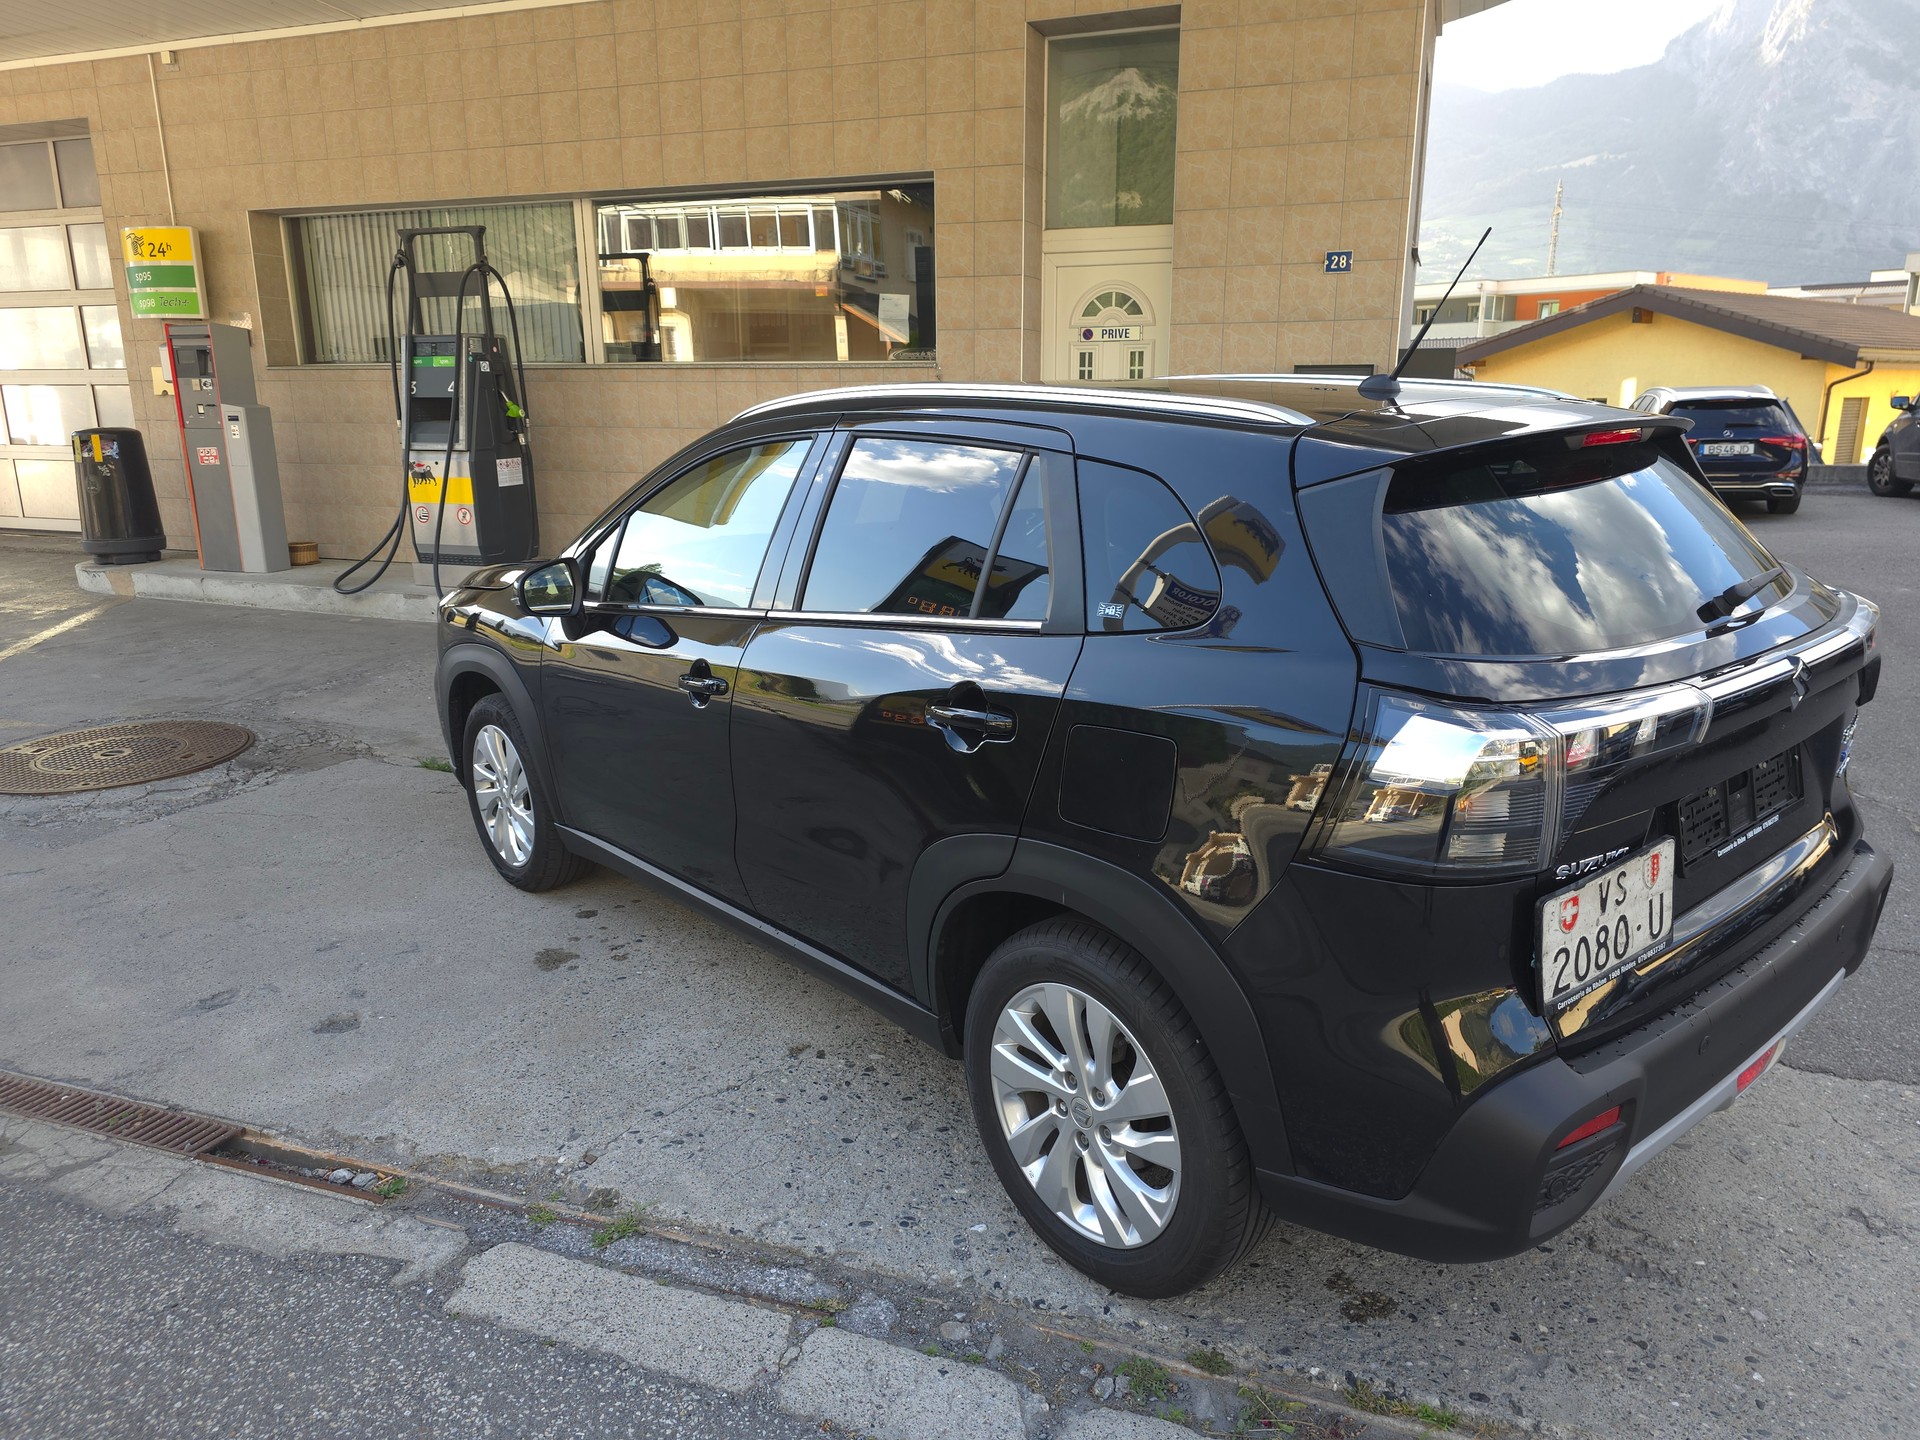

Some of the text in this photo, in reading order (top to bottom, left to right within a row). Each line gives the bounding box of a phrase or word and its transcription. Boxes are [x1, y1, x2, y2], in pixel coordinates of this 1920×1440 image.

[147, 242, 172, 258] 24h
[1330, 255, 1347, 269] 28
[135, 271, 152, 284] sp95
[138, 298, 156, 310] sp98
[1101, 328, 1130, 339] PRIVE
[410, 380, 455, 394] 3 4
[1599, 871, 1627, 913] VS
[1557, 990, 1585, 1011] Carrosserie
[1585, 986, 1592, 995] du
[1592, 977, 1607, 990] Rhône
[1608, 969, 1621, 980] 1908
[1621, 961, 1637, 974] Riddes
